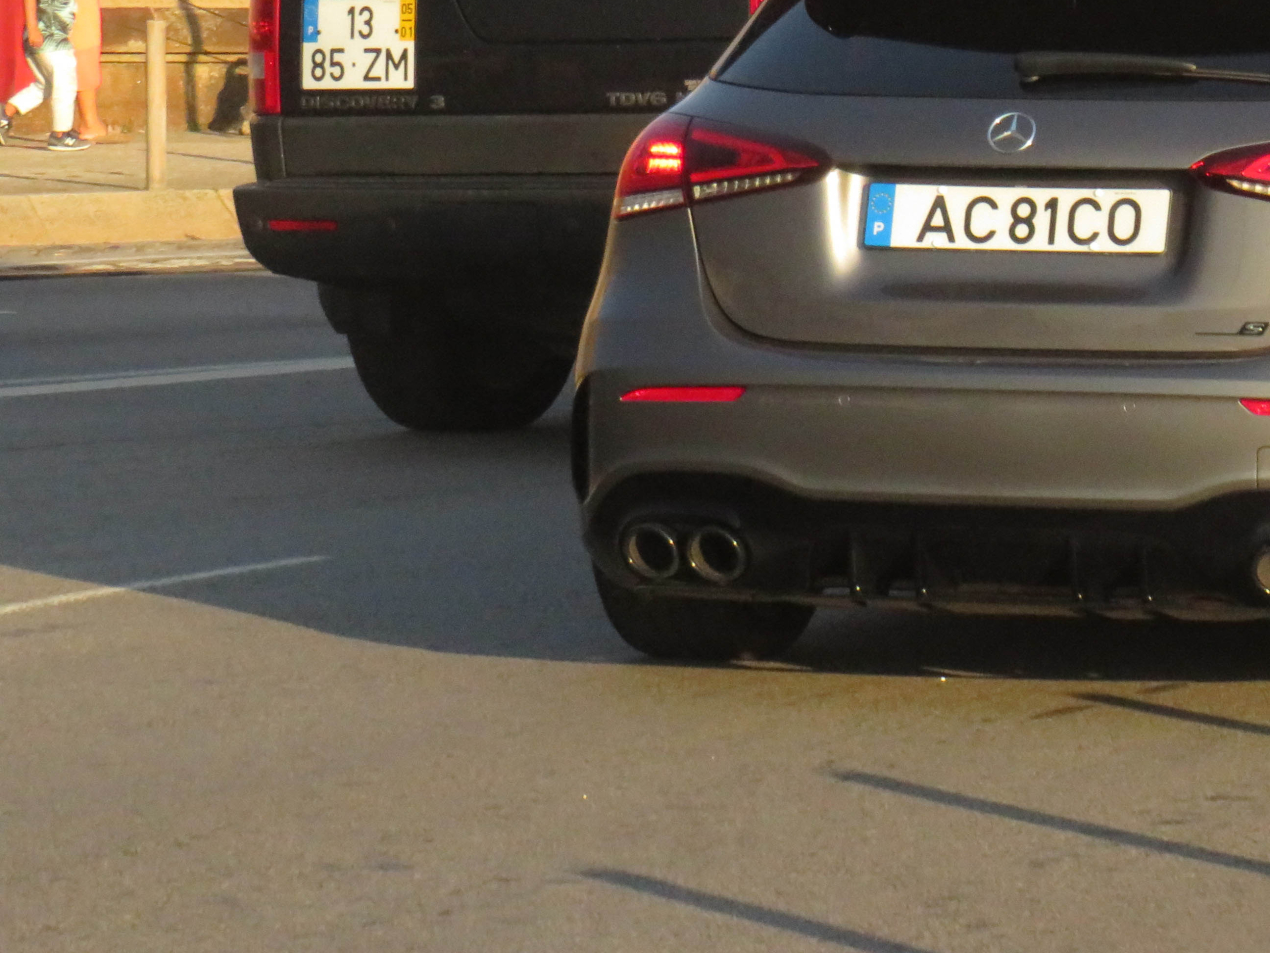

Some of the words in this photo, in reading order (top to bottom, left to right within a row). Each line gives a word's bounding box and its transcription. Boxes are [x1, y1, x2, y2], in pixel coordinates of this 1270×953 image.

[401, 3, 413, 15] 05
[307, 25, 314, 35] P
[347, 5, 374, 40] 13
[400, 26, 413, 38] 01
[302, 95, 418, 110] DISCOVERY
[430, 95, 446, 110] 3
[915, 194, 1143, 247] AC81CO
[873, 221, 885, 236] P
